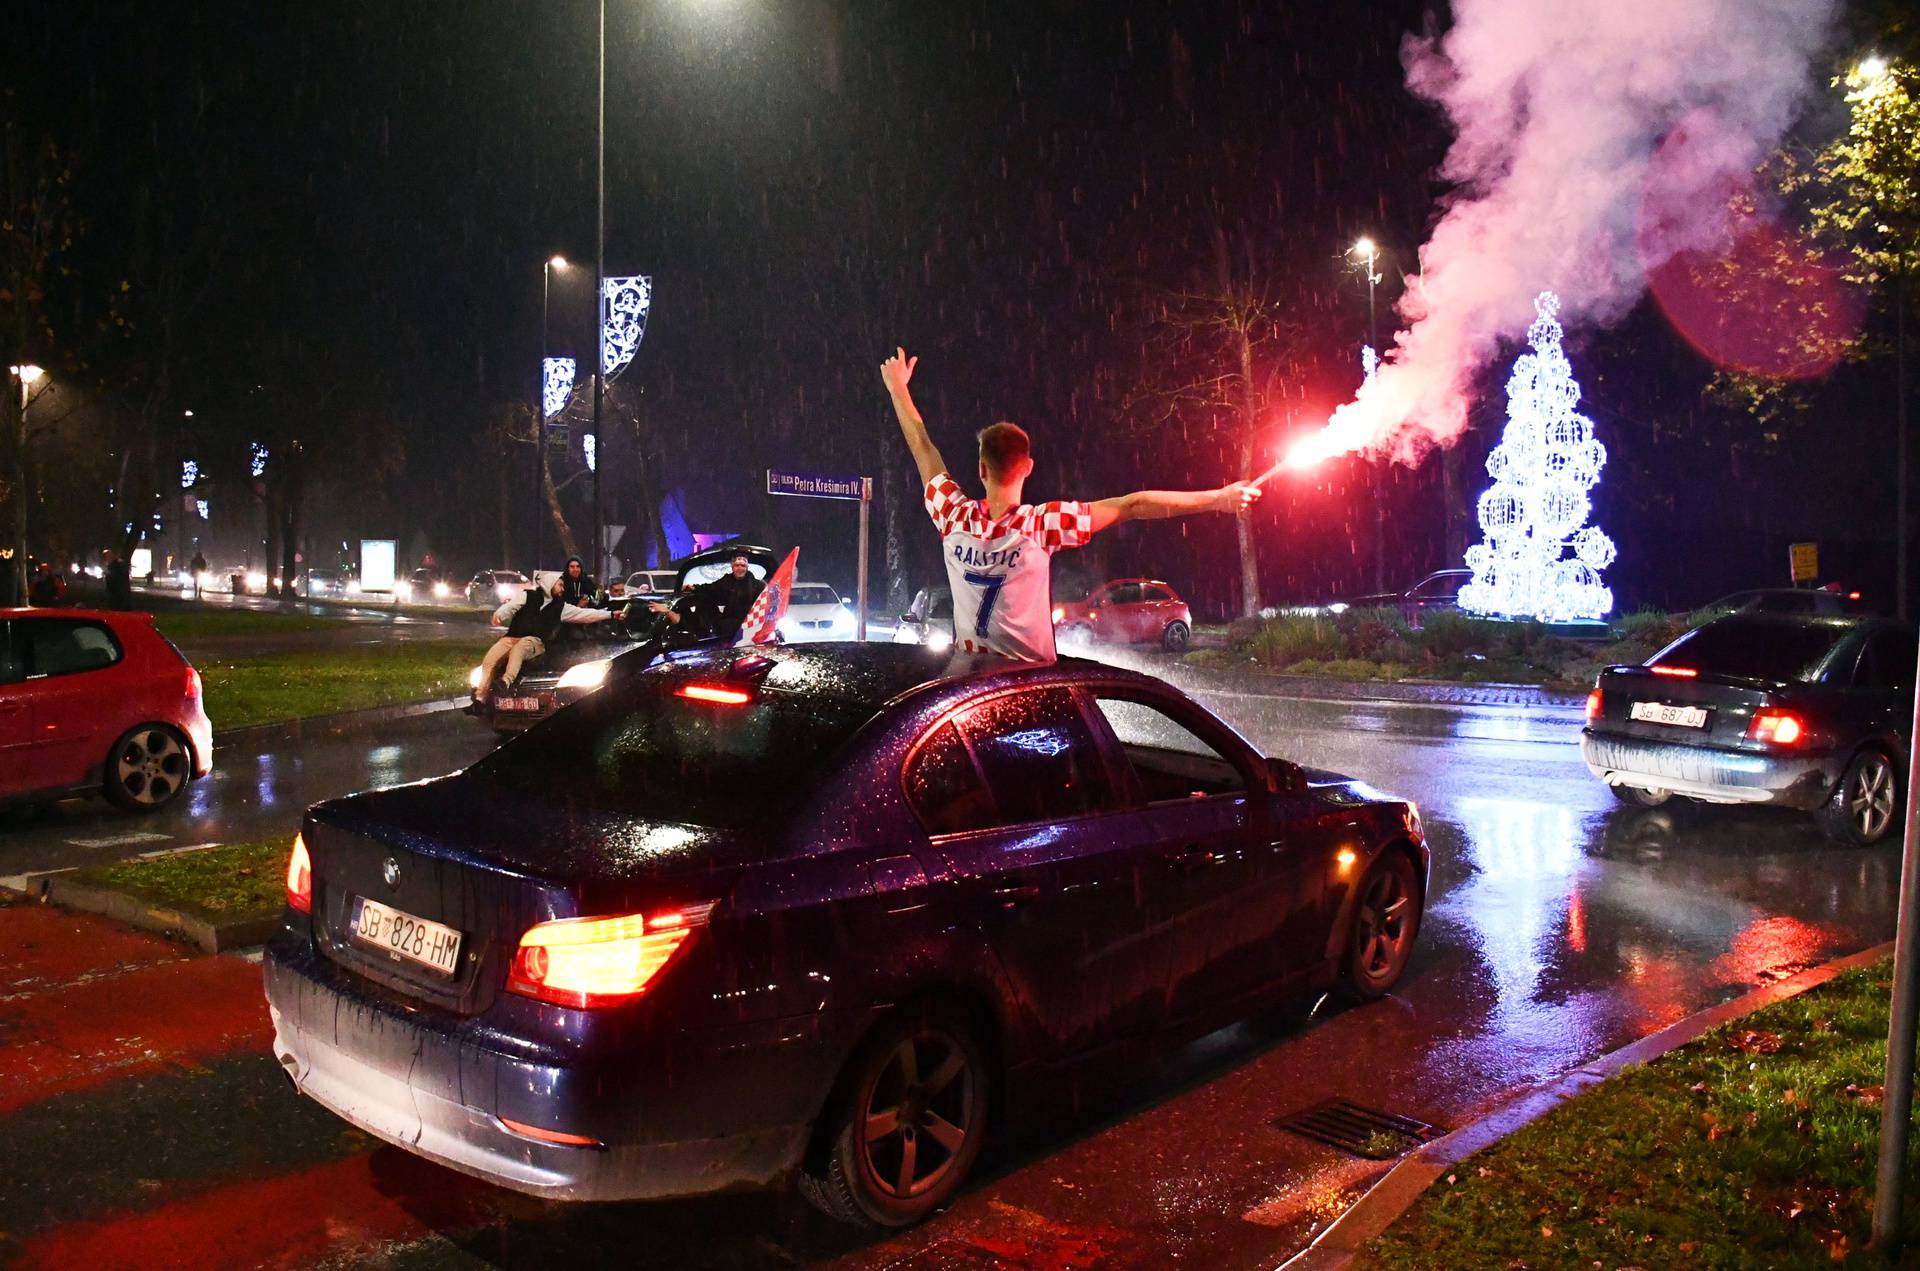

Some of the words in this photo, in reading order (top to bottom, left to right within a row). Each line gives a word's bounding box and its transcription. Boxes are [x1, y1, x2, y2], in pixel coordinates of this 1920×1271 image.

[794, 476, 814, 492] Petra
[815, 478, 849, 494] Krešimira
[850, 481, 860, 495] IV.
[963, 569, 1007, 639] 7
[360, 905, 382, 938] SB
